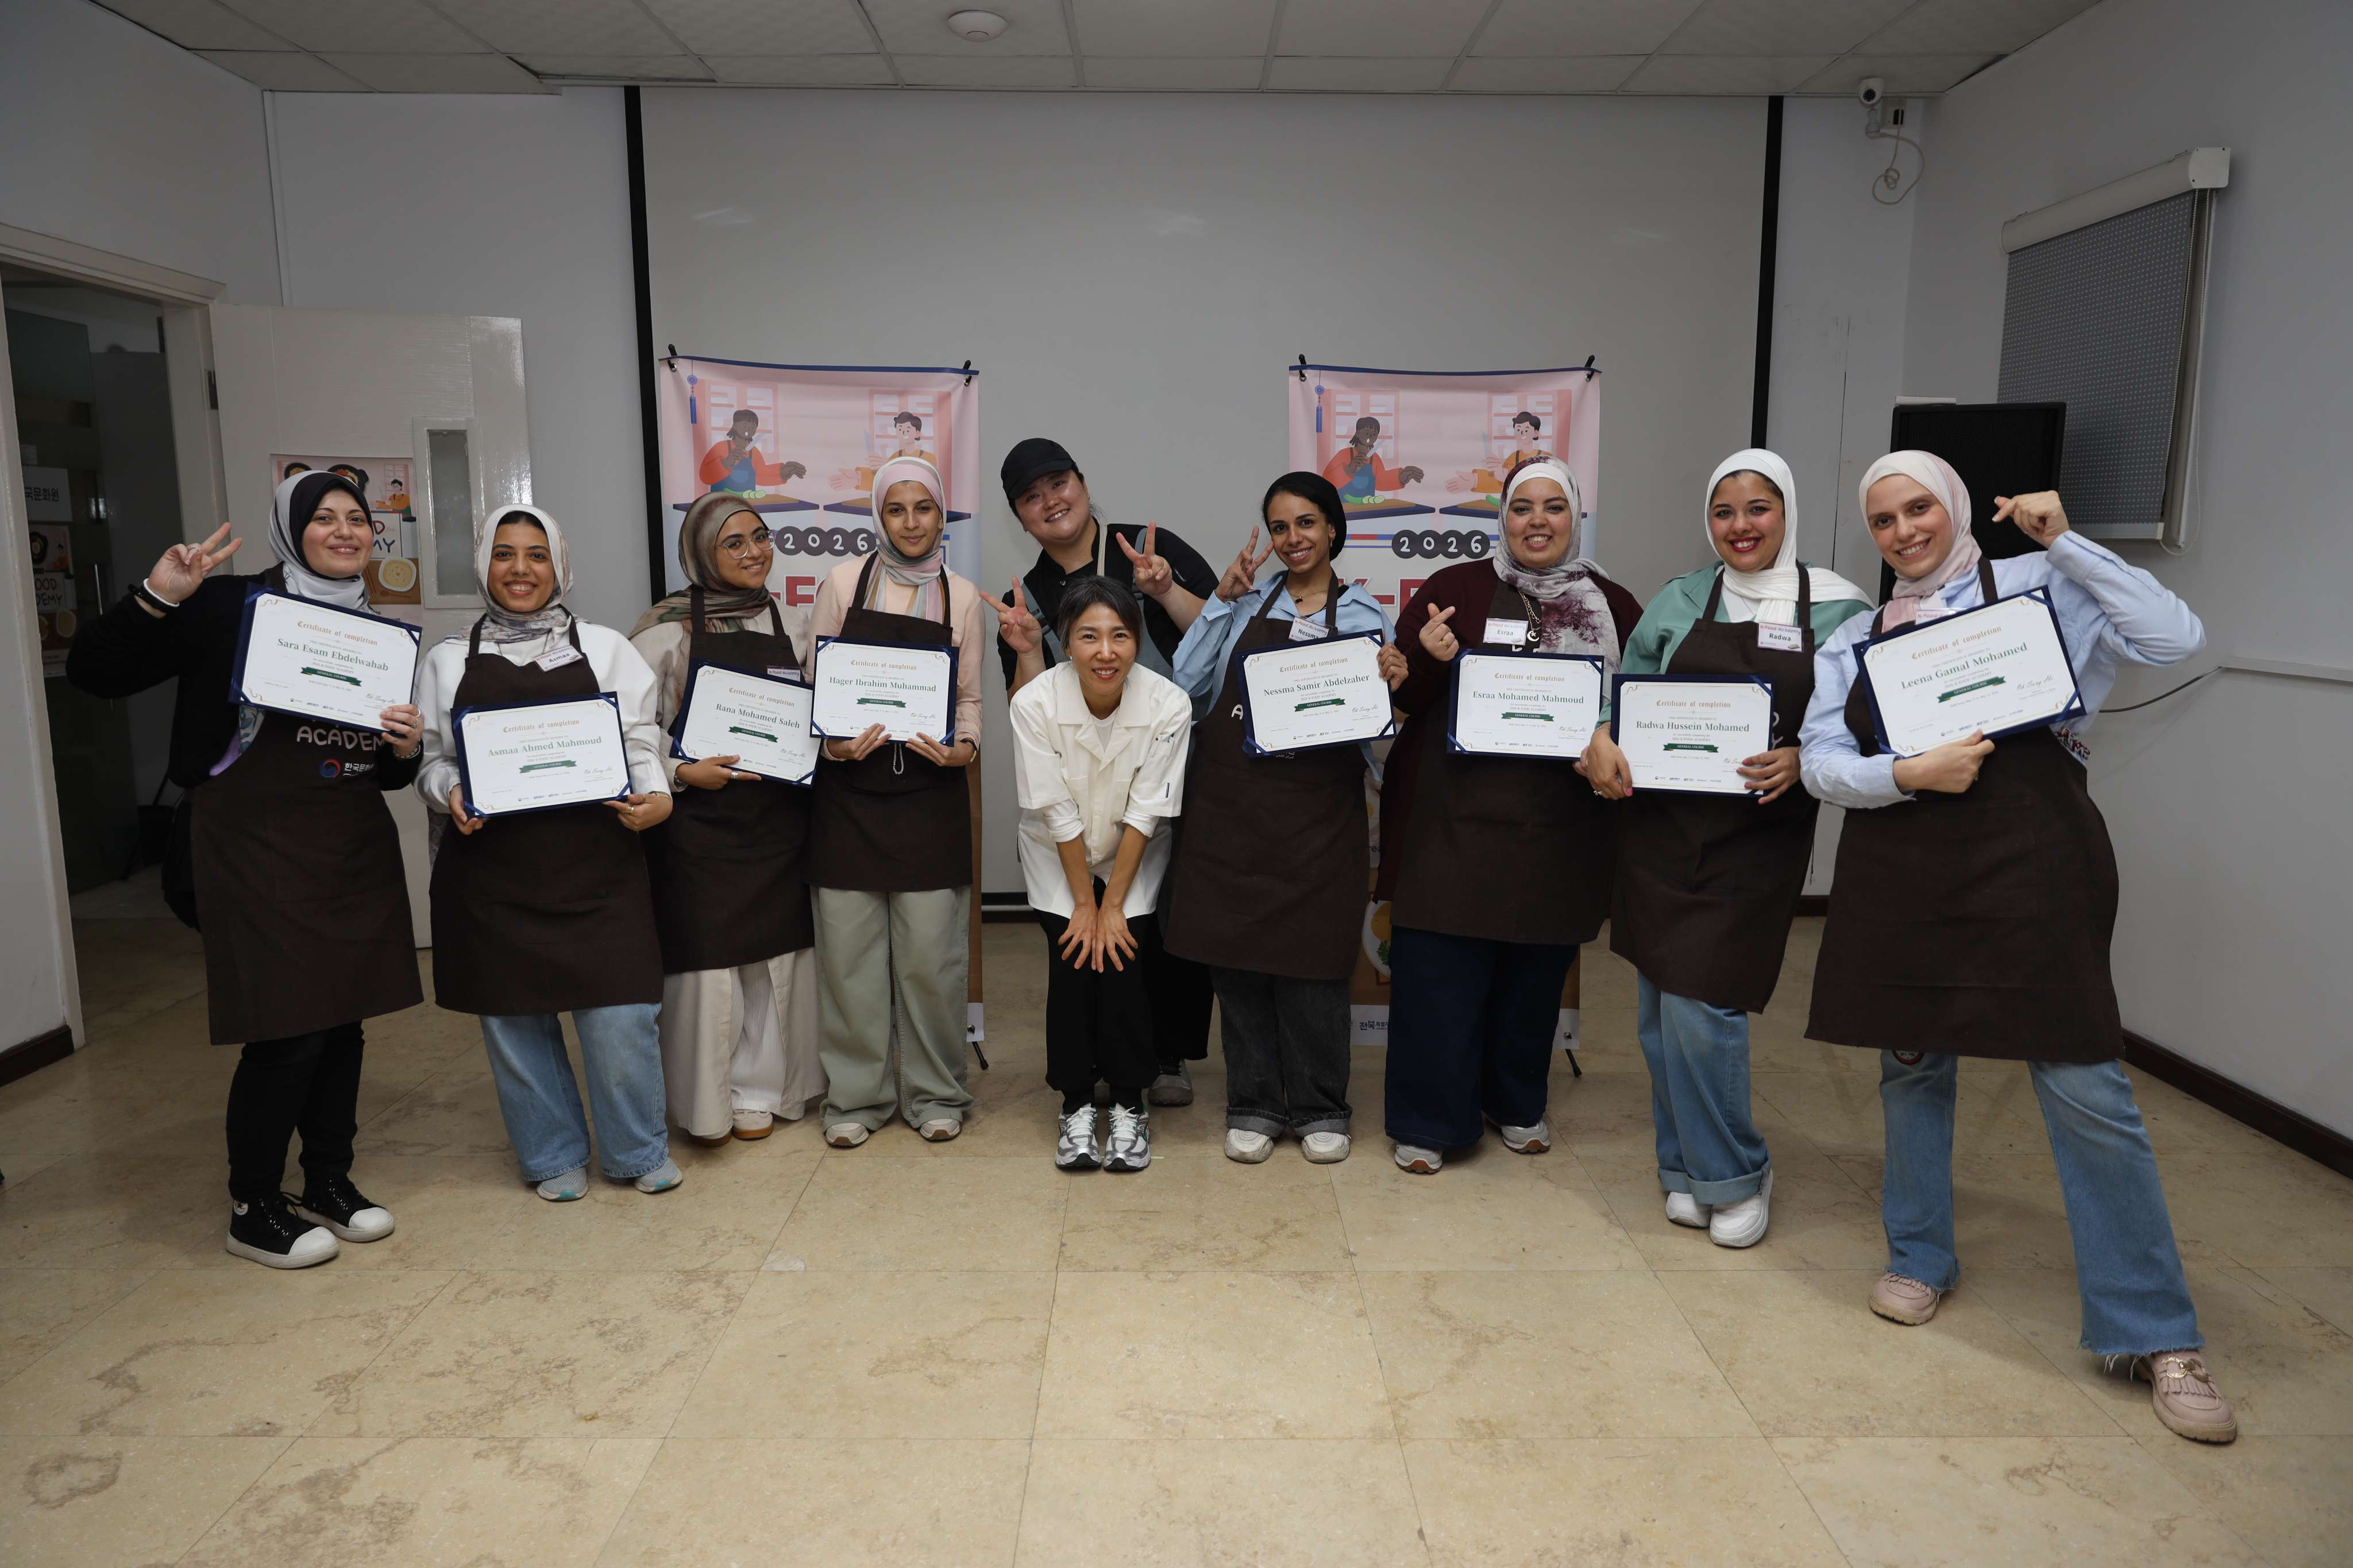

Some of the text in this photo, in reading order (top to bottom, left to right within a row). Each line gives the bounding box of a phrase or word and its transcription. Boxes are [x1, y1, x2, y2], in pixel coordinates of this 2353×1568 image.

[24, 486, 60, 502] 국문화원
[783, 533, 868, 551] 2026
[1399, 535, 1482, 553] 2026
[35, 578, 56, 590] OOD
[297, 621, 331, 634] Certificate
[344, 634, 377, 645] completion
[1298, 628, 1318, 639] Nessma
[1769, 633, 1791, 641] Radwa
[1911, 644, 1948, 659] Certificate
[1962, 627, 2001, 643] completion
[277, 639, 299, 650] Sara
[303, 644, 328, 656] Esam
[331, 652, 388, 670] Ebdelwahab
[549, 653, 570, 662] Asmaa
[1901, 643, 2027, 689] Leena Gamal Mohamed
[830, 677, 854, 685] Hager
[890, 682, 936, 691] Muhammad
[1264, 688, 1294, 696] Nessma
[1297, 682, 1321, 690] Samir
[1324, 675, 1370, 686] Abdelzaher
[729, 688, 757, 697] Certificate
[766, 697, 794, 706] completion
[716, 704, 735, 713] Rana
[739, 709, 777, 723] Mohamed
[778, 719, 800, 728] Saleh
[296, 725, 385, 751] ACADEM
[522, 742, 554, 752] Ahmed
[556, 737, 601, 747] Mahmoud
